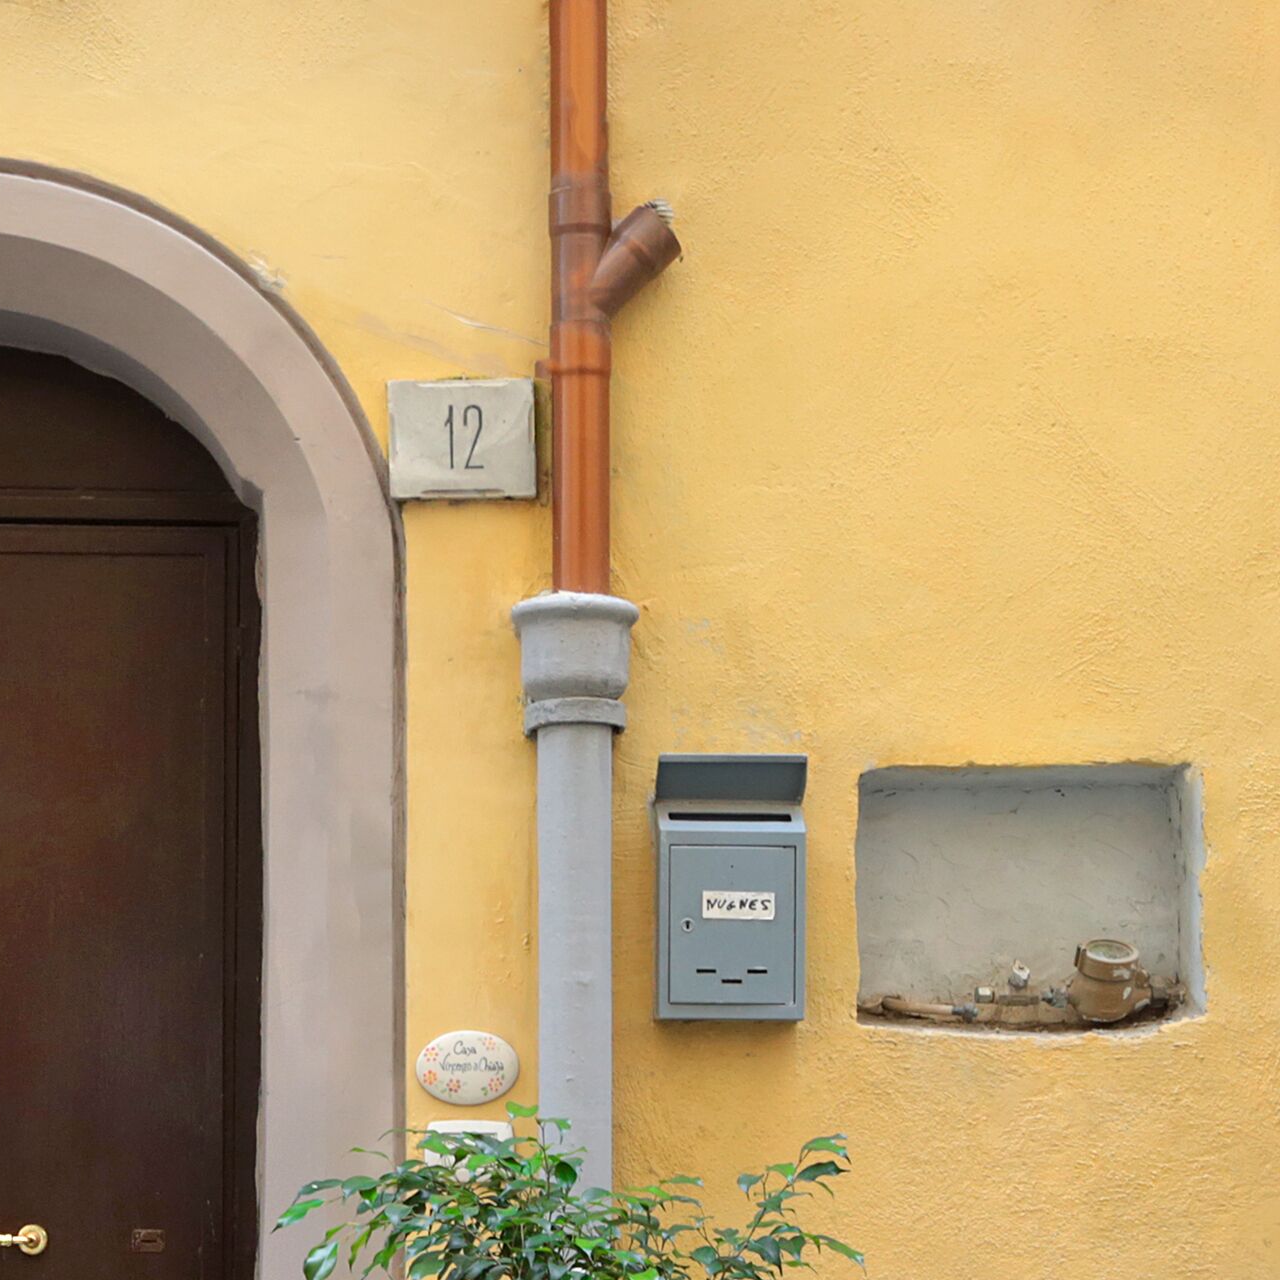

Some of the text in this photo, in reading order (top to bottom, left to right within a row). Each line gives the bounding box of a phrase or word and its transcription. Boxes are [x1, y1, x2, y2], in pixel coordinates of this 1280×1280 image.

[444, 404, 484, 469] 12
[706, 898, 772, 911] NUGNES
[453, 1040, 477, 1056] Casa
